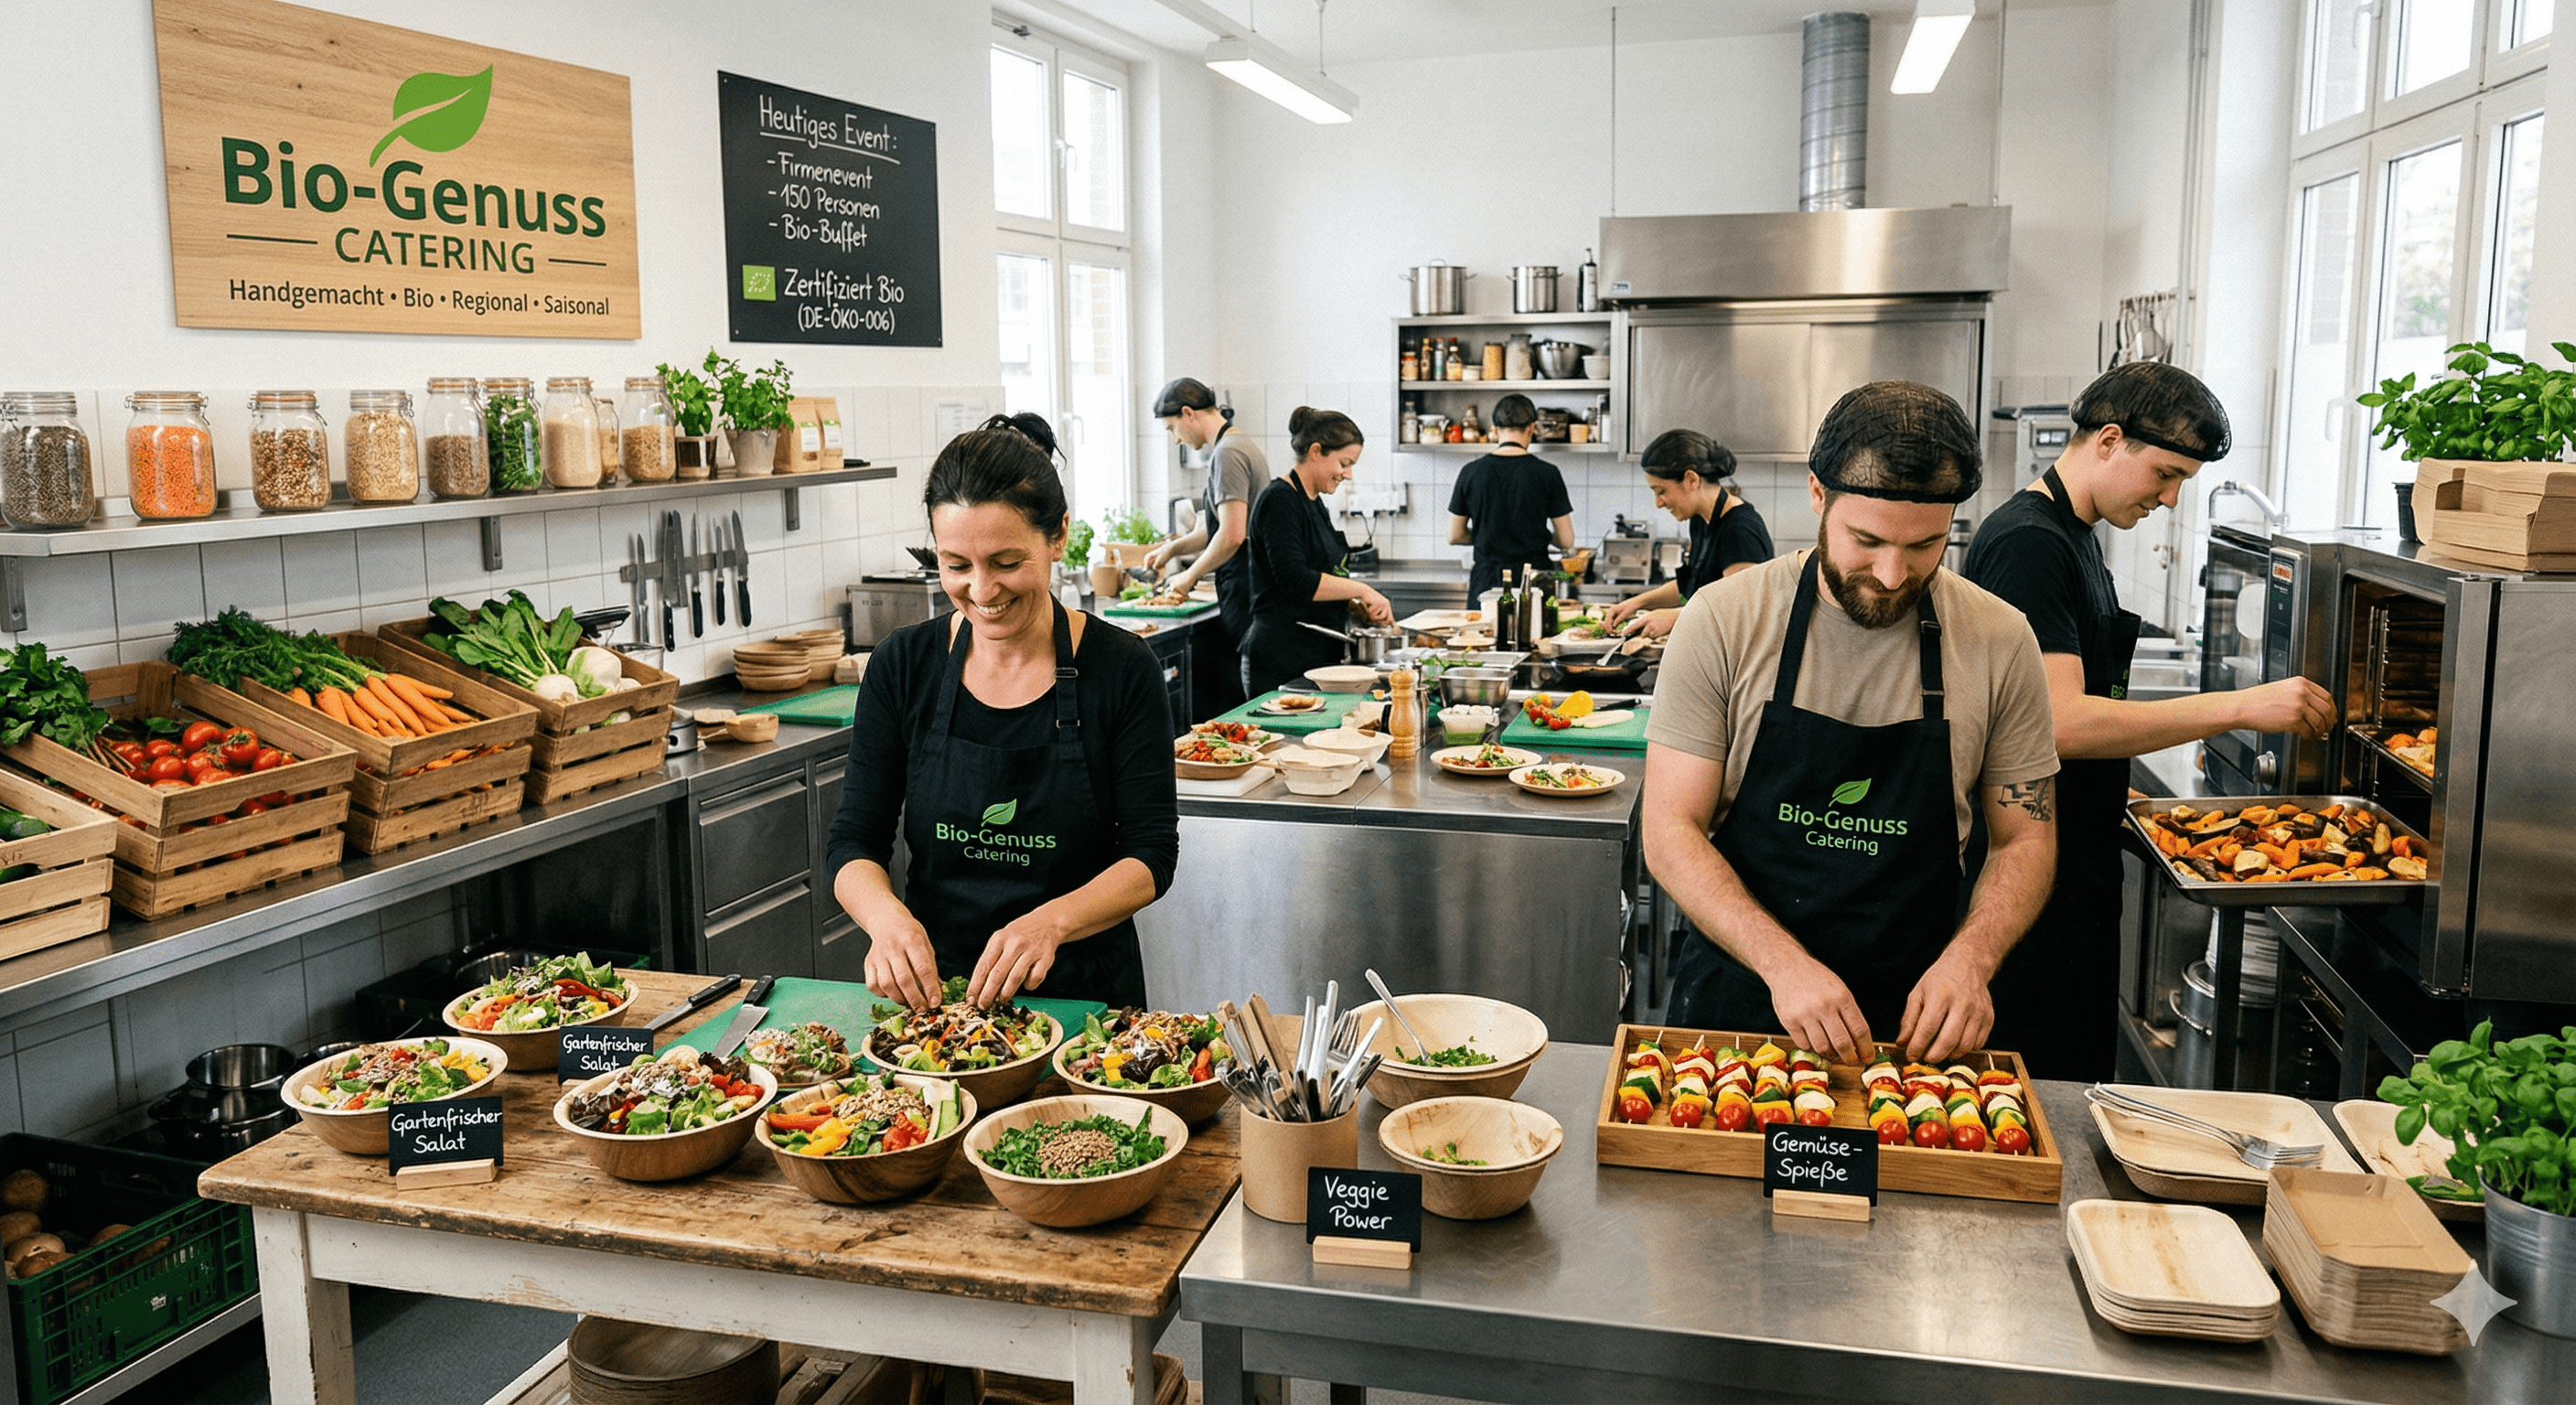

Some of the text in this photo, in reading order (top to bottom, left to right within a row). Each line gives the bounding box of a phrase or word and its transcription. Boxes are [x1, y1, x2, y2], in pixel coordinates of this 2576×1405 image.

[759, 94, 897, 152] Heutiges Event:
[221, 137, 606, 238] Bio-Genuss
[813, 187, 880, 220] Personen
[335, 227, 534, 273] CATERING
[230, 279, 609, 316] Handgemacht Bio Regional Saisonal
[784, 268, 905, 307] Zertifiziert Bio
[798, 302, 896, 336] (DE-ÖKO-006)
[1777, 803, 1908, 835] Bio-Genuss
[936, 822, 1057, 848] Bio-Genuss
[1806, 831, 1879, 856] Catering
[963, 846, 1030, 866] Catering
[563, 1034, 648, 1056] Gartenfrischer
[580, 1055, 620, 1072] Salat
[392, 1107, 503, 1137] Gartenfrischer
[413, 1131, 467, 1153] Salat
[1772, 1132, 1862, 1156] Gemüse-
[1776, 1157, 1849, 1188] Spieße
[1325, 1175, 1390, 1209] Veggie
[1328, 1205, 1393, 1229] Power
